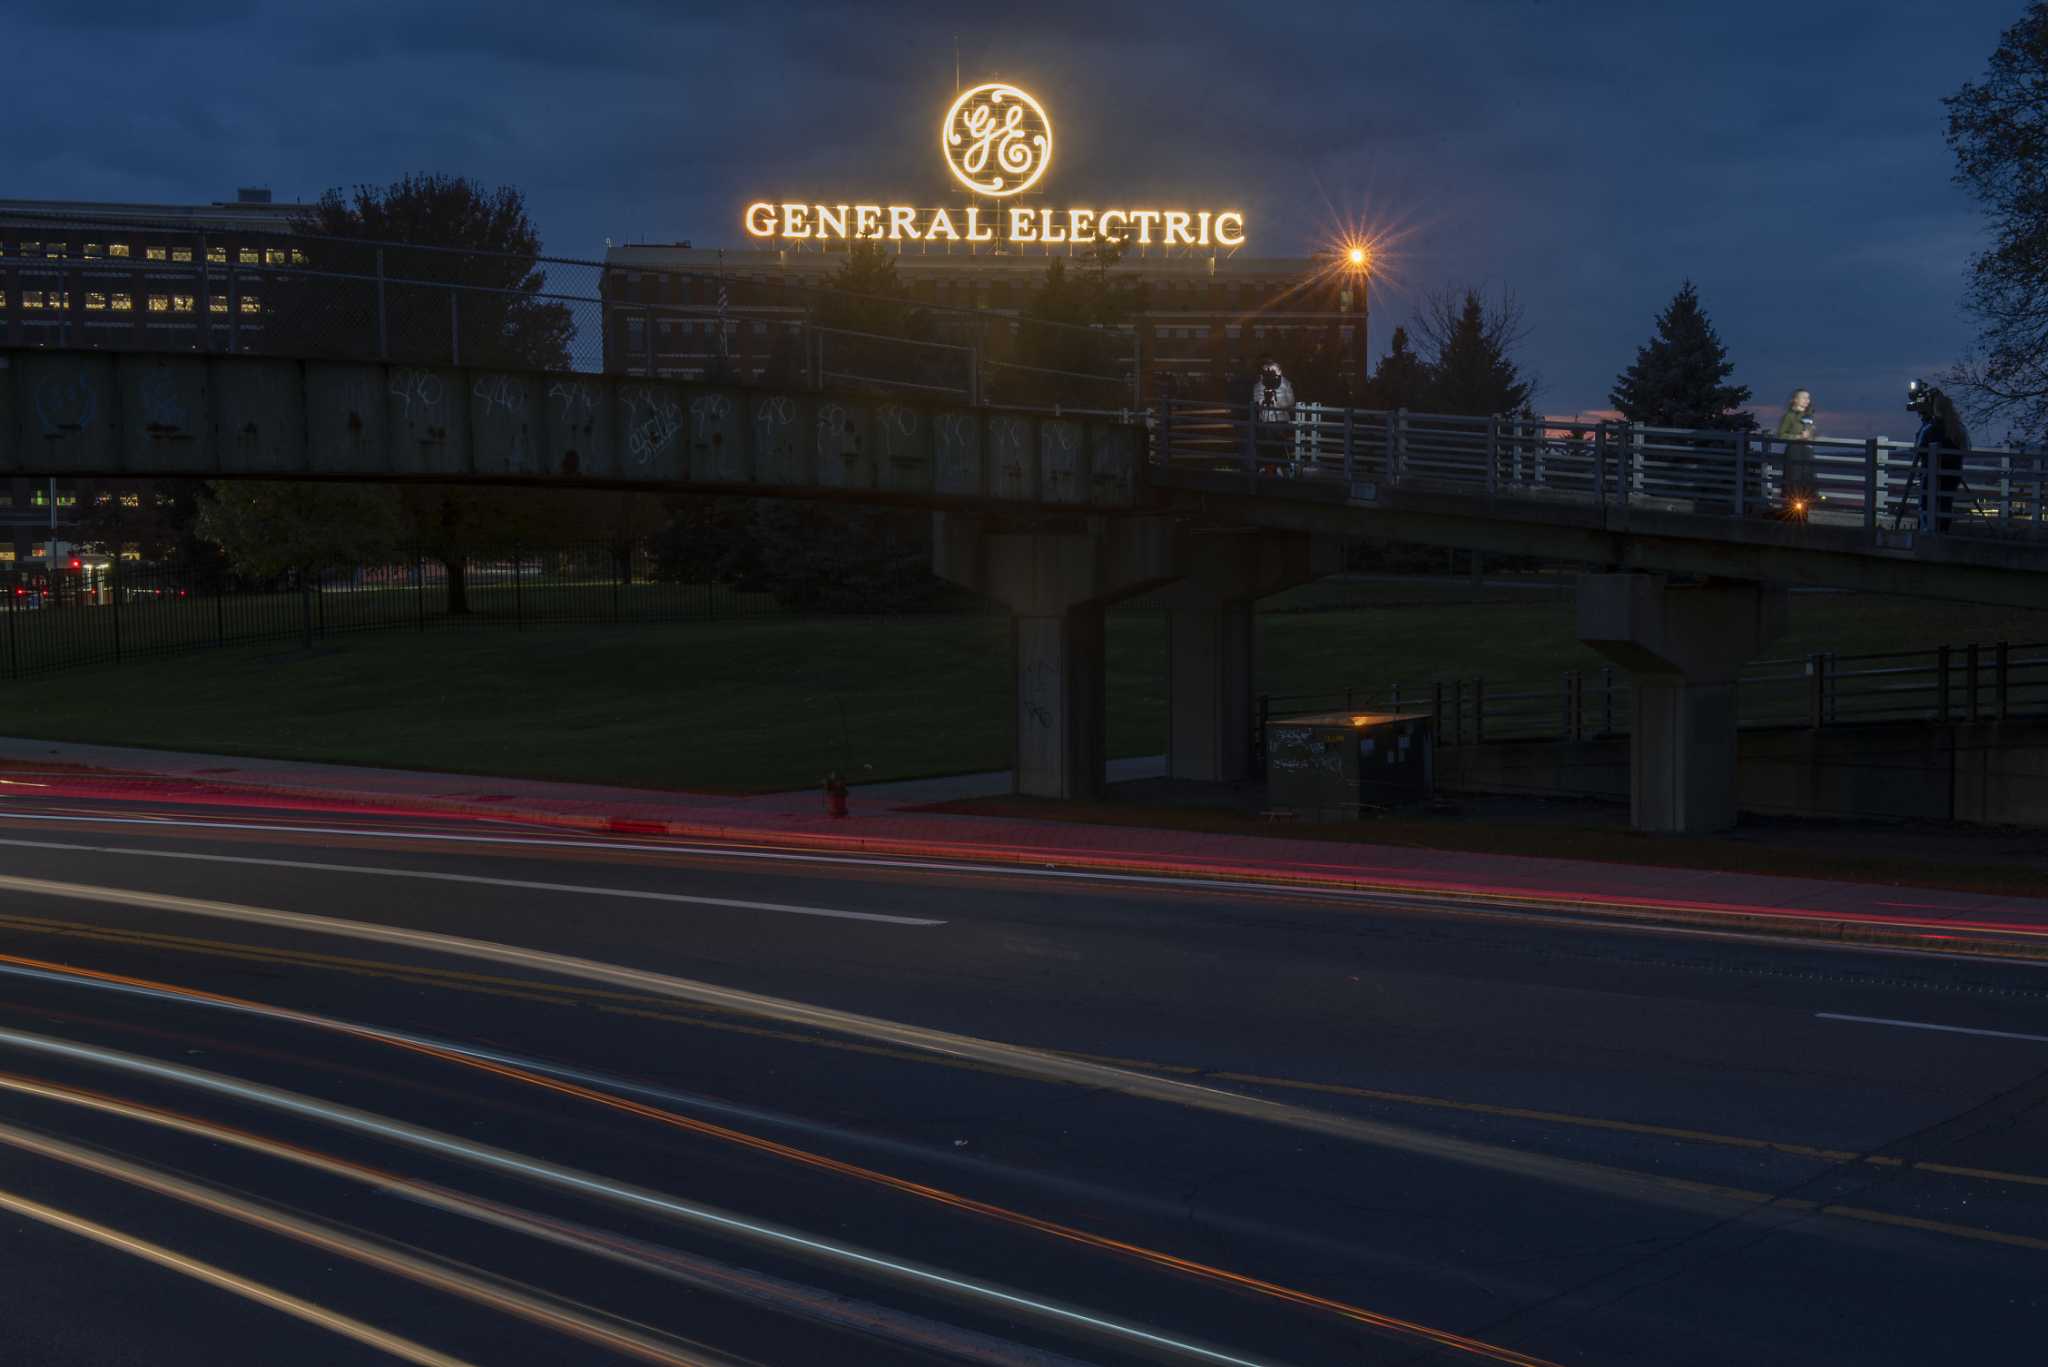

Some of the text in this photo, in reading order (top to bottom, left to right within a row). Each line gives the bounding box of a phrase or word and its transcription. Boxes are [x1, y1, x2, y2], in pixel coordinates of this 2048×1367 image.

[963, 105, 1033, 174] GE
[745, 203, 1245, 245] GENERAL ELECTRIC
